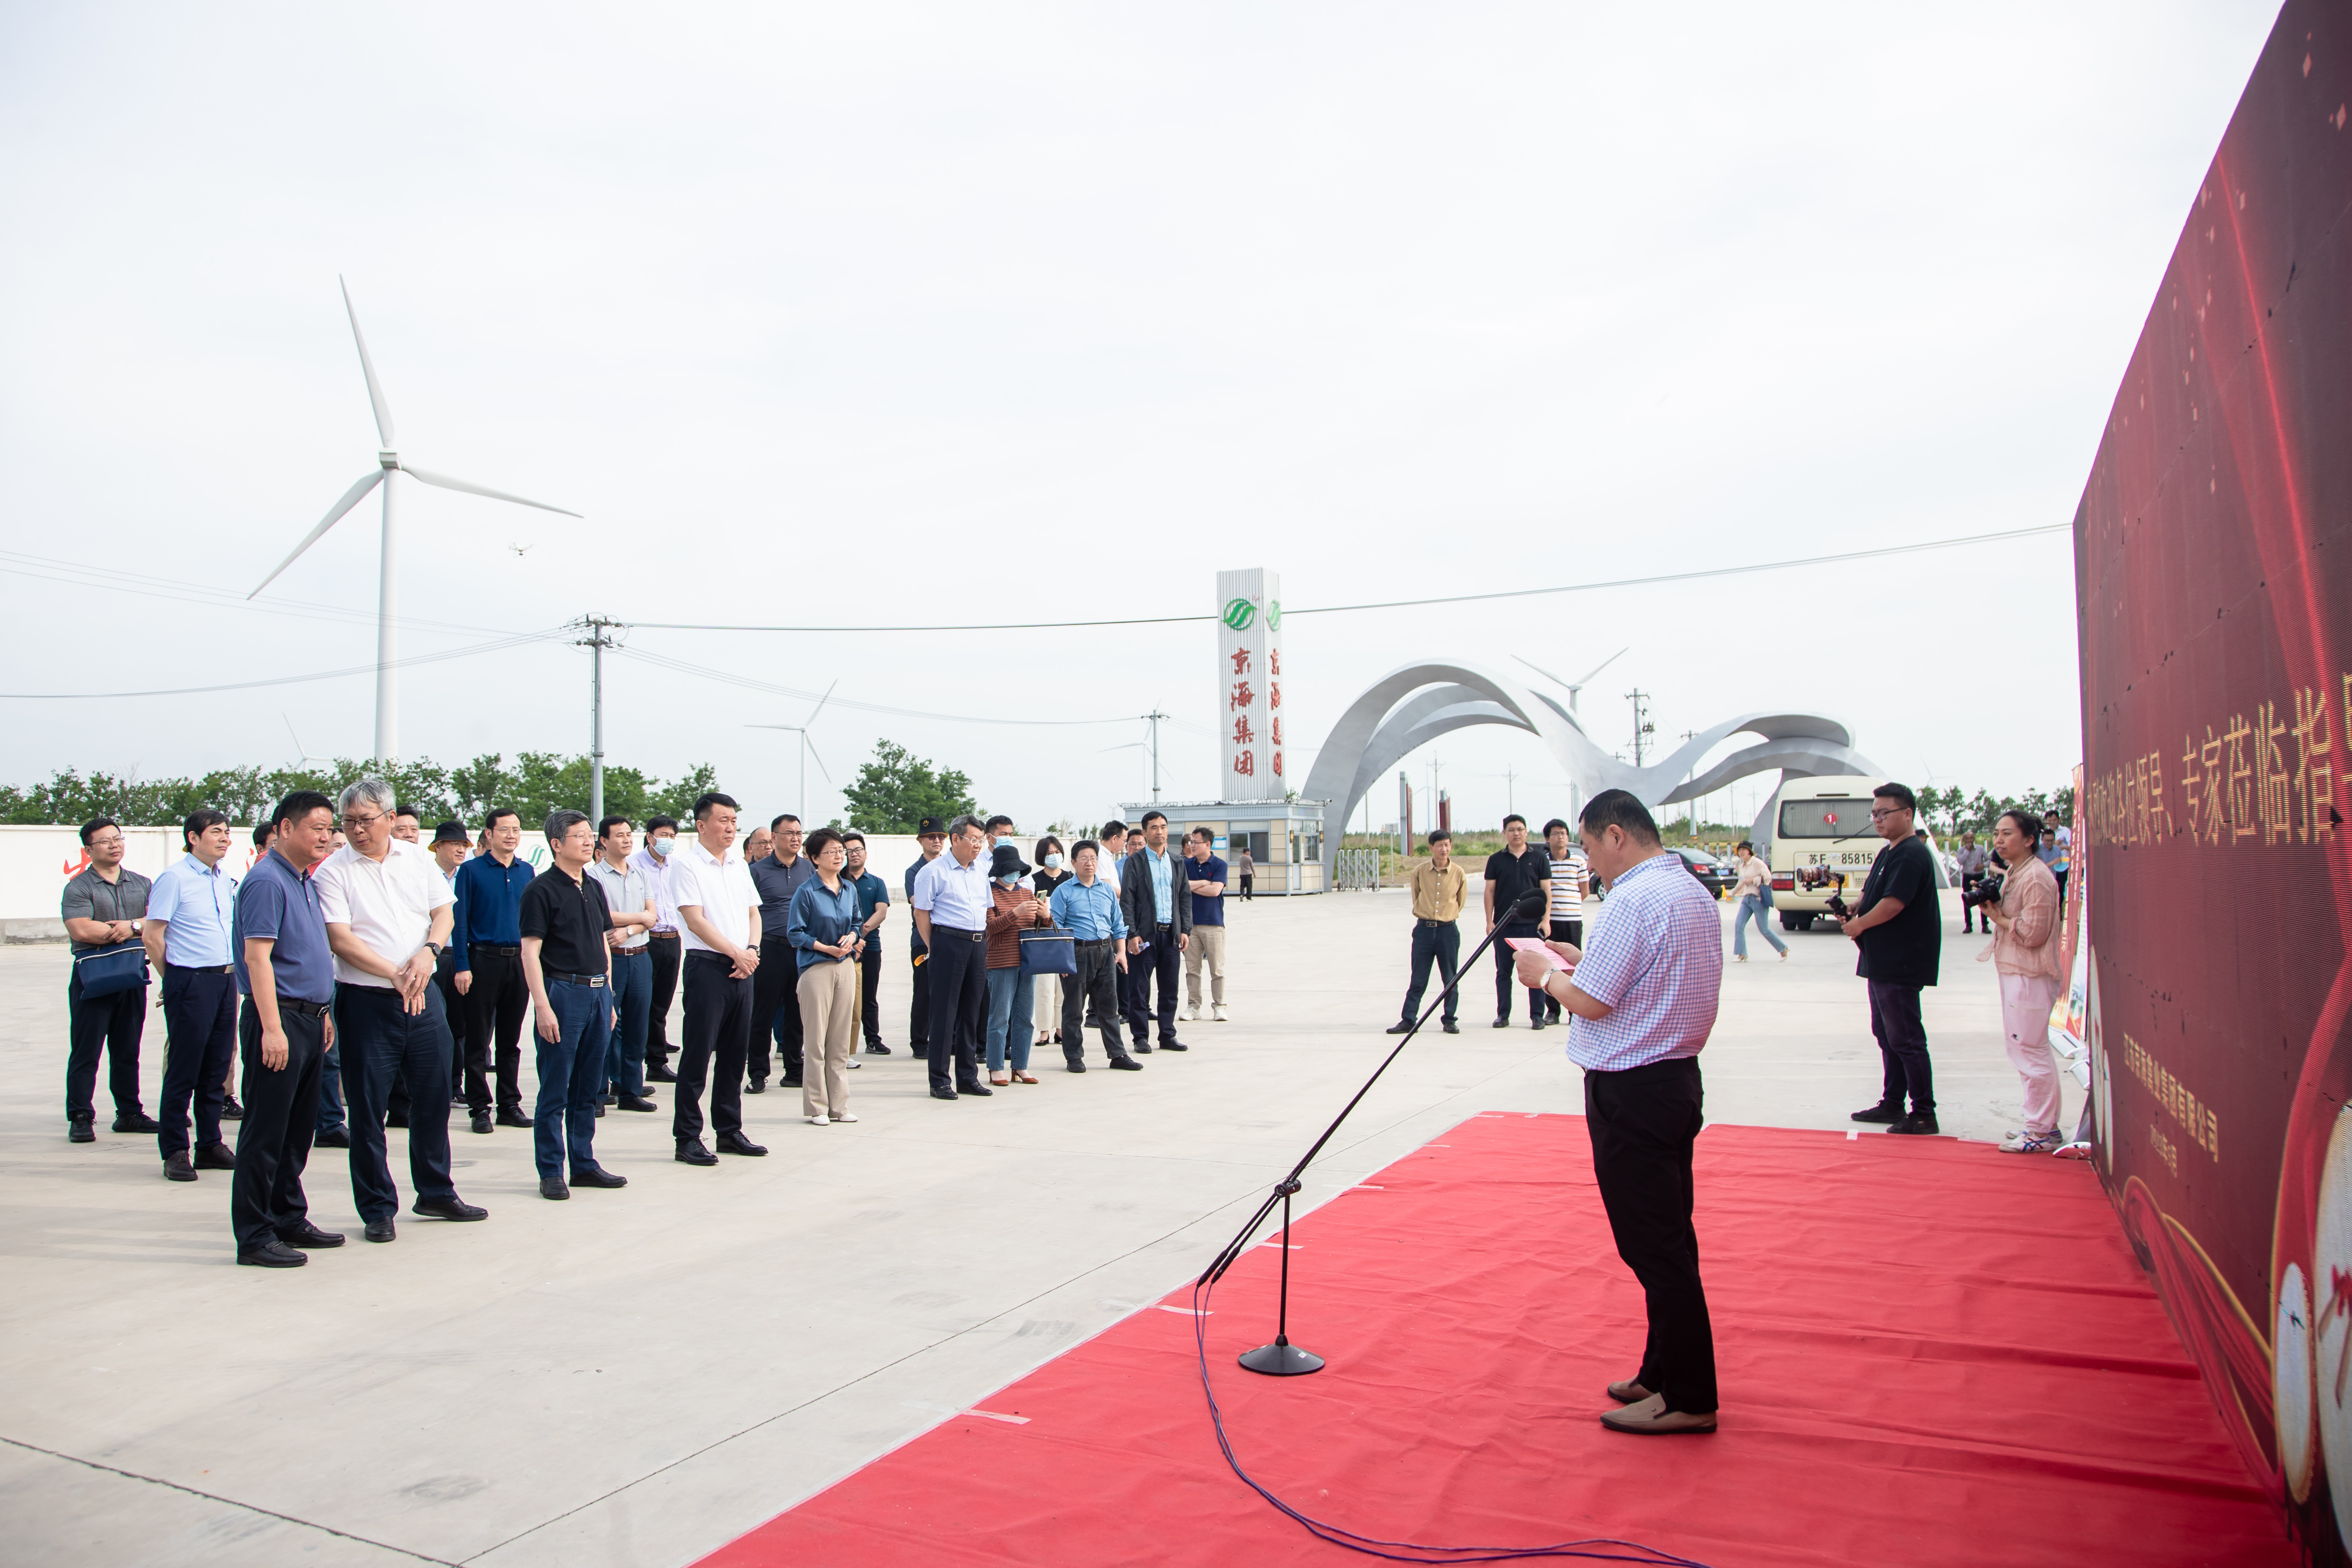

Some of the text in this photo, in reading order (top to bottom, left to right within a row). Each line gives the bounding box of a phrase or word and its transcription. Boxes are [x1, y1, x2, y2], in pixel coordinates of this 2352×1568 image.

[1231, 647, 1255, 777] 京海集团
[1270, 648, 1282, 777] 京海集团
[1827, 814, 1832, 823] 1
[1841, 853, 1873, 864] 85815
